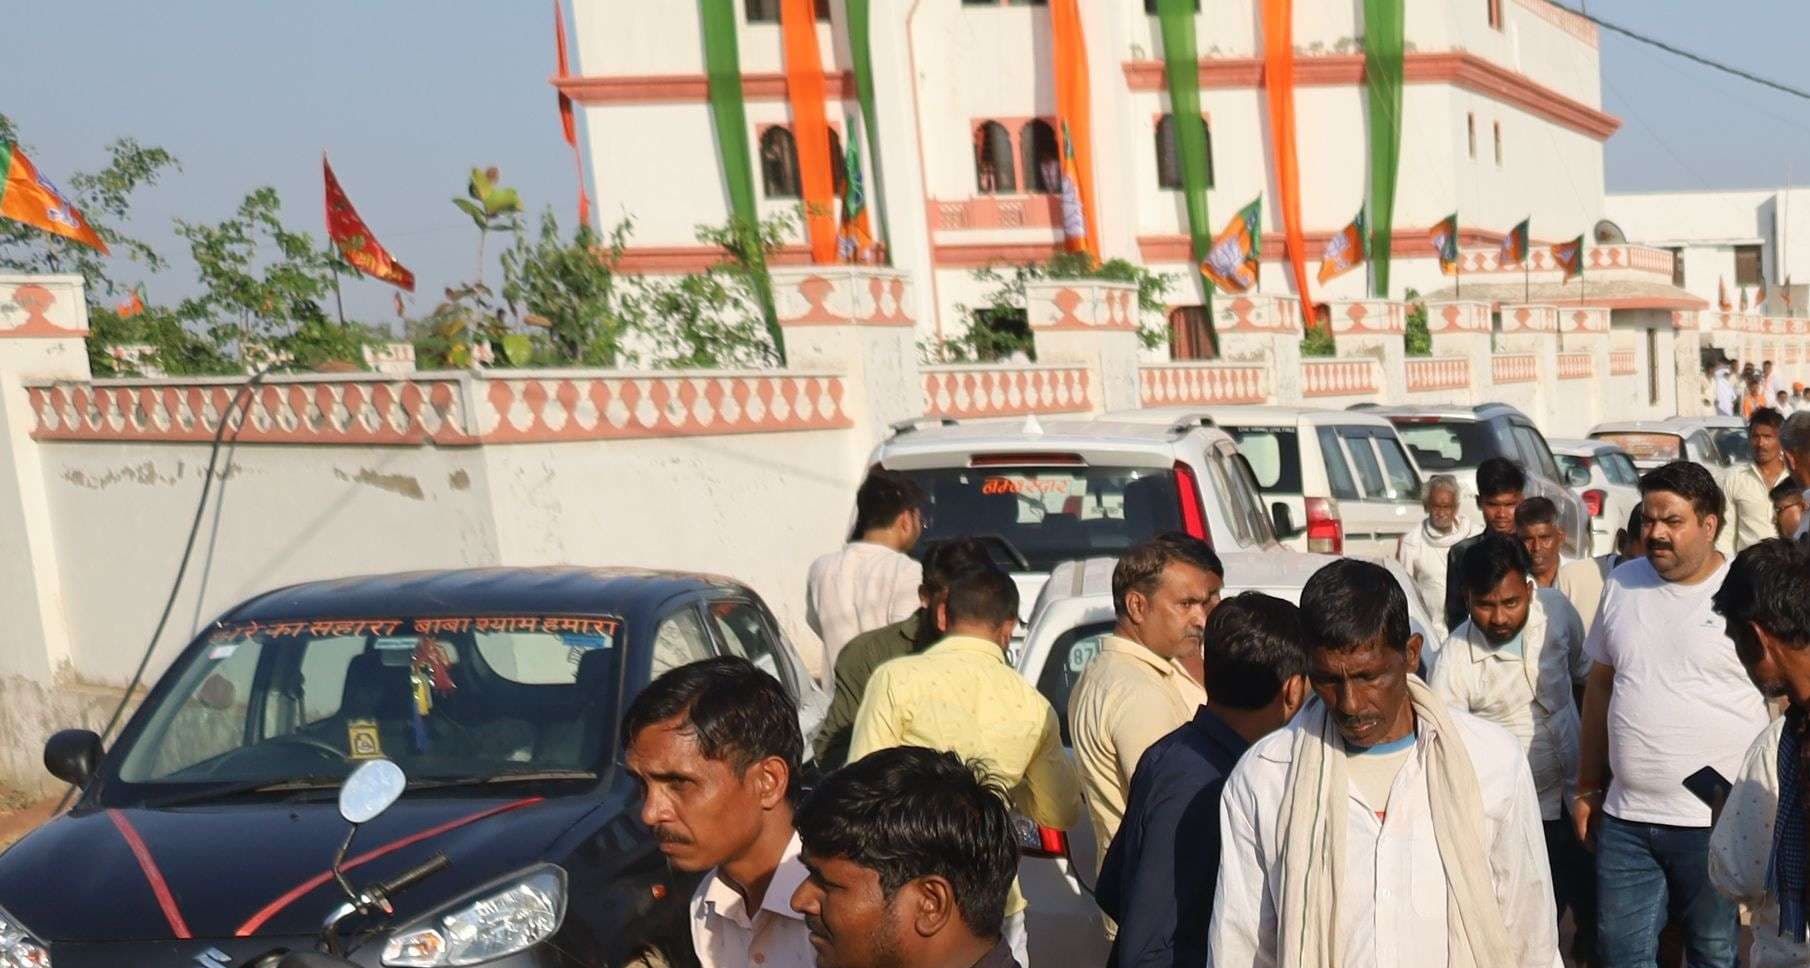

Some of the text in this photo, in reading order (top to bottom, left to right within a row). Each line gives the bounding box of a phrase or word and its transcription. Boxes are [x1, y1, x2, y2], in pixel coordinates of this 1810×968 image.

[309, 619, 404, 638] सहारा
[414, 617, 474, 635] बाबा
[475, 617, 542, 634] श्याम
[543, 616, 620, 637] हमारा
